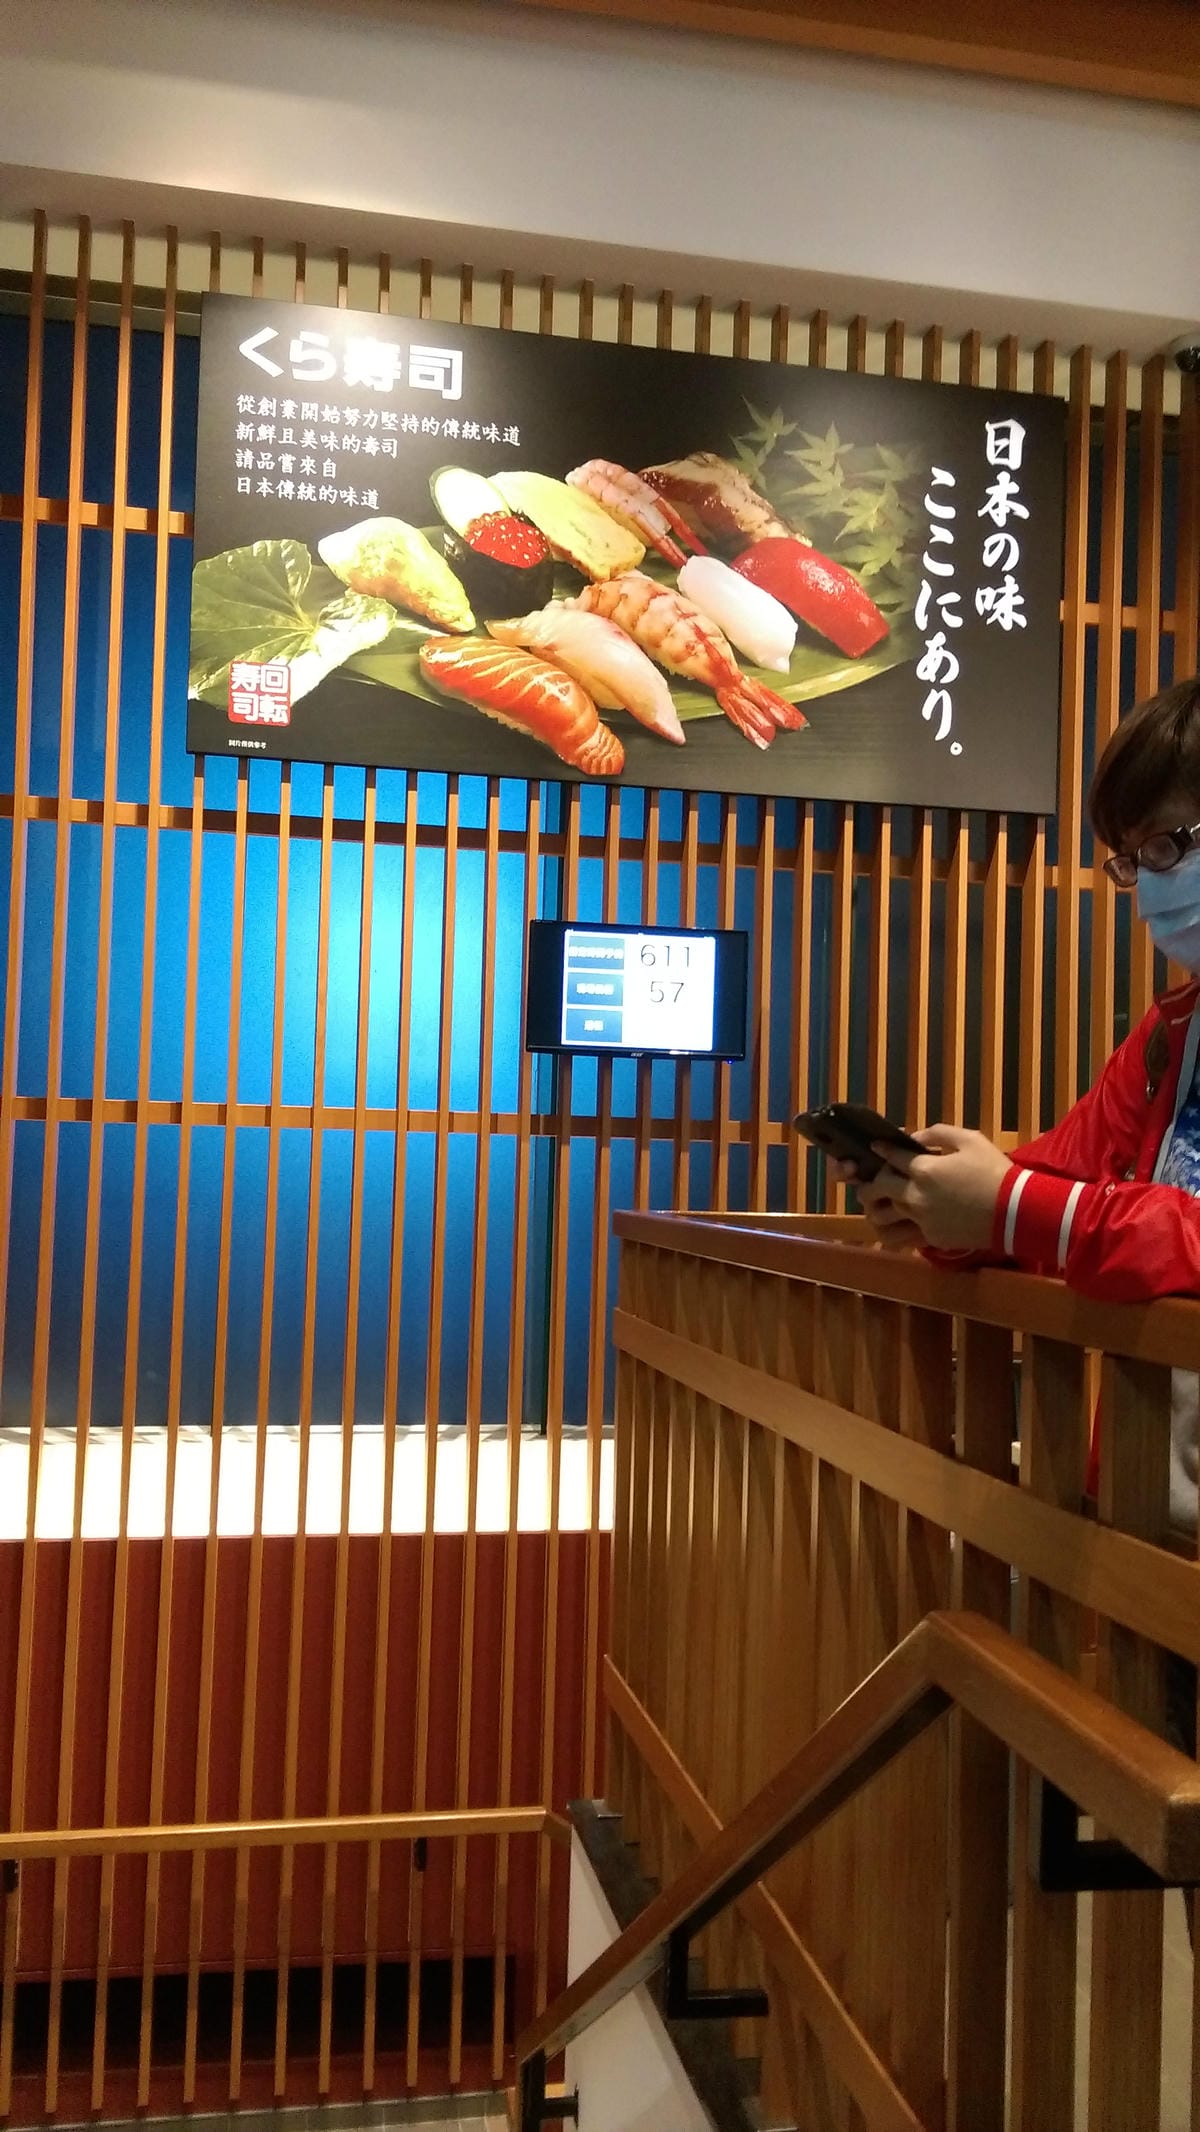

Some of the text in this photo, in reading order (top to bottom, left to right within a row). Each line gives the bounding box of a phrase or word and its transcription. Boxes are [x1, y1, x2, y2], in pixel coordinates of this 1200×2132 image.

[239, 326, 464, 400] くら寿司
[235, 421, 399, 459] 新鮮且美味的壽司
[236, 394, 521, 446] 從創業開始努力堅持的傳統味道
[237, 476, 380, 510] 日本傳統的味道
[975, 419, 1030, 631] 日本の味
[915, 466, 963, 756] ここにあり。
[641, 944, 690, 967] 611
[650, 980, 685, 1003] 57
